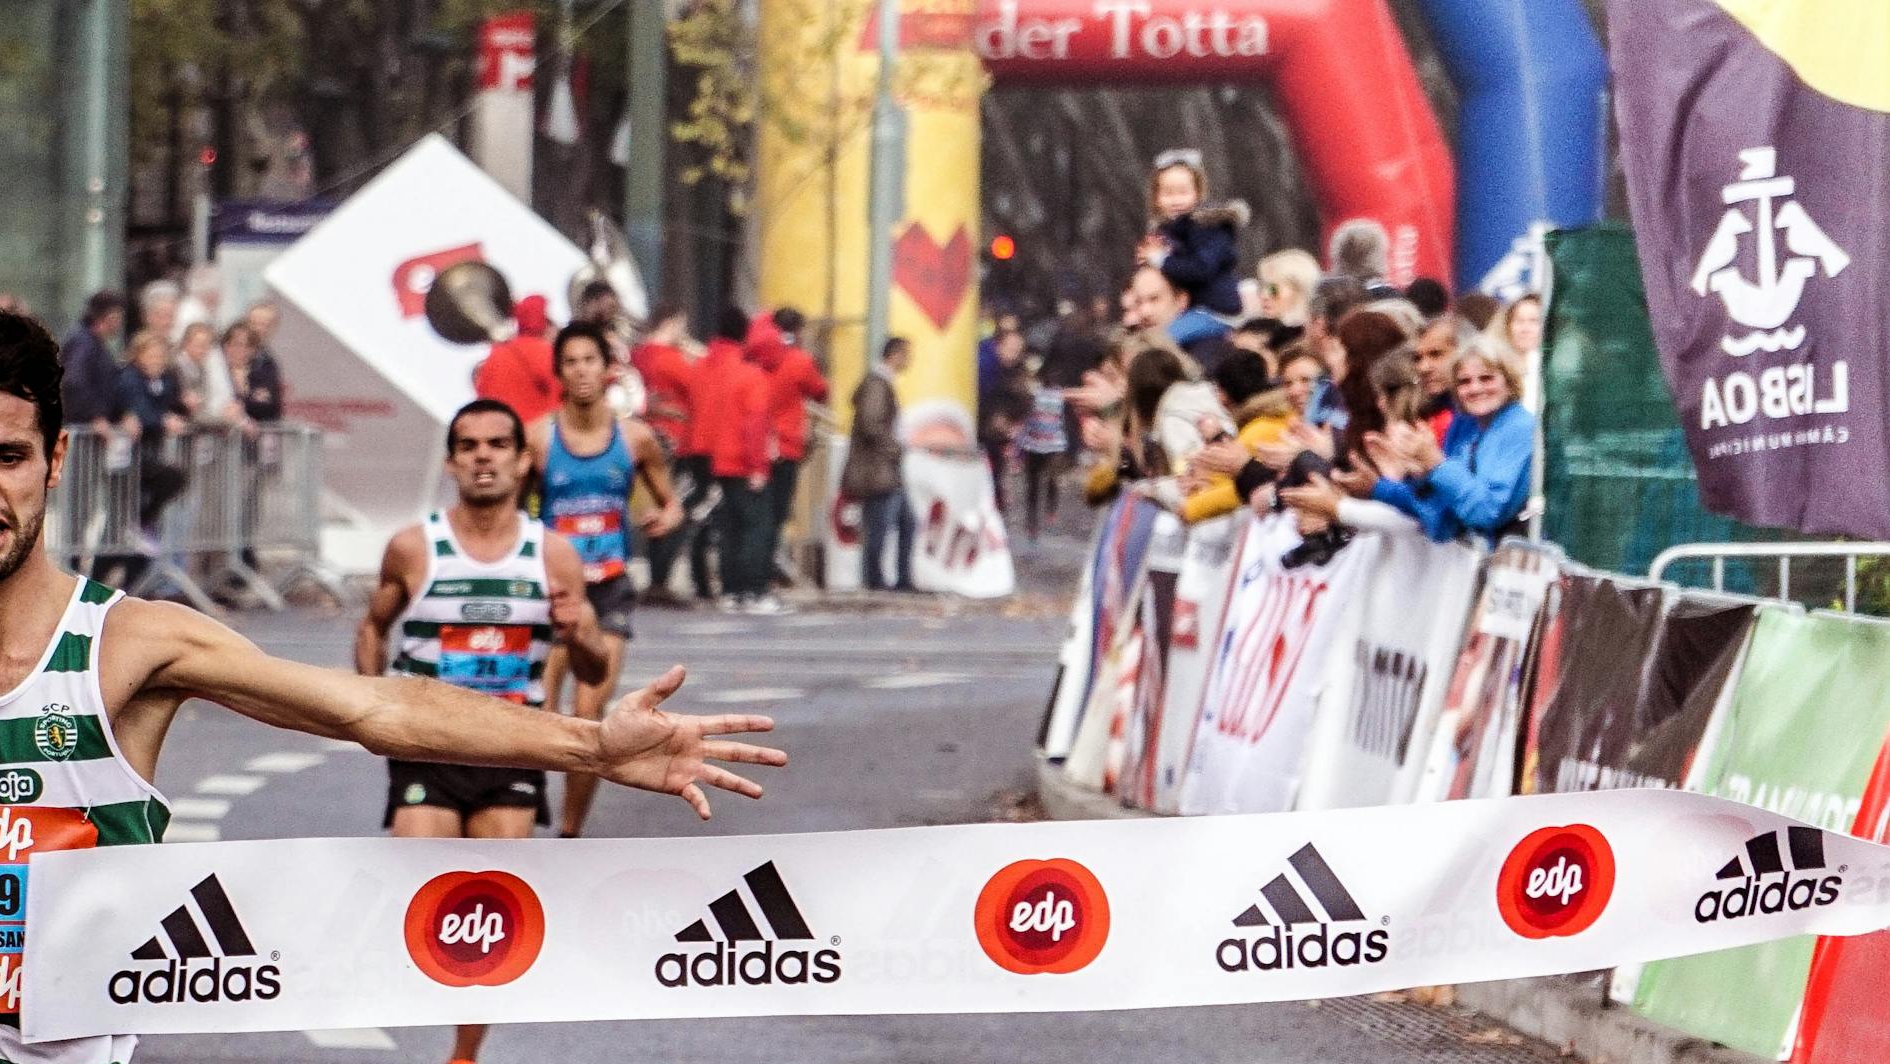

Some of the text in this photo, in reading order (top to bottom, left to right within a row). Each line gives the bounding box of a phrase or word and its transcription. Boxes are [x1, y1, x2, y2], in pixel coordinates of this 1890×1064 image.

[1094, 1, 1270, 58] Totta
[42, 703, 71, 715] SCP
[1526, 856, 1583, 905] edp
[1695, 871, 1843, 923] adidas
[440, 903, 505, 953] edp
[1010, 891, 1076, 941] edp
[655, 940, 842, 988] adidas
[1216, 924, 1389, 972] adidas
[108, 957, 281, 1005] adidas
